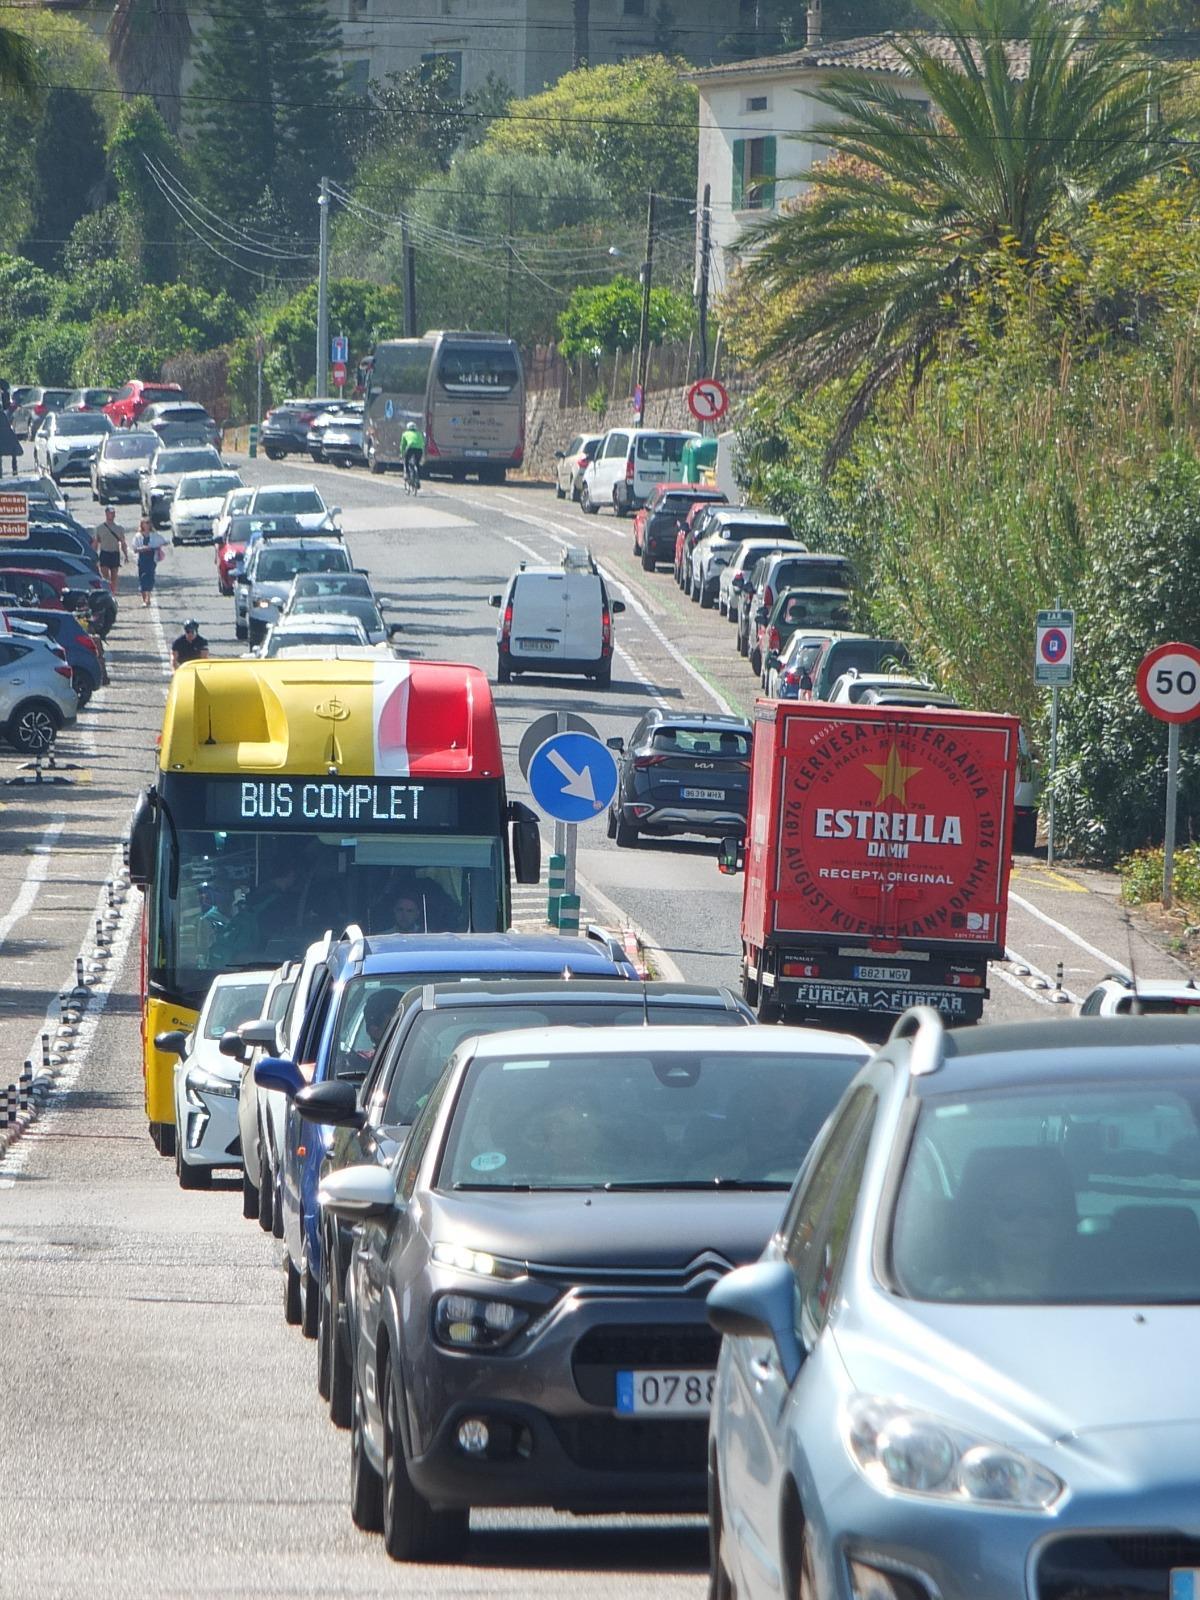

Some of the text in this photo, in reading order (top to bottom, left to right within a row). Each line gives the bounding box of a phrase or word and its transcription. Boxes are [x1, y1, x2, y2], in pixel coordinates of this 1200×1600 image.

[1156, 670, 1196, 695] 50
[794, 724, 867, 791] CERVESA
[241, 783, 424, 819] BUS COMPLET
[815, 808, 963, 845] ESTRELLA
[867, 841, 909, 859] DAMM
[785, 848, 833, 913] AUGUST
[950, 859, 990, 909] DAMM
[819, 868, 954, 885] RECEPTA ORIGINAL
[861, 968, 885, 979] 6821
[798, 987, 869, 1004] FURCAR
[891, 993, 962, 1010] FURCAR
